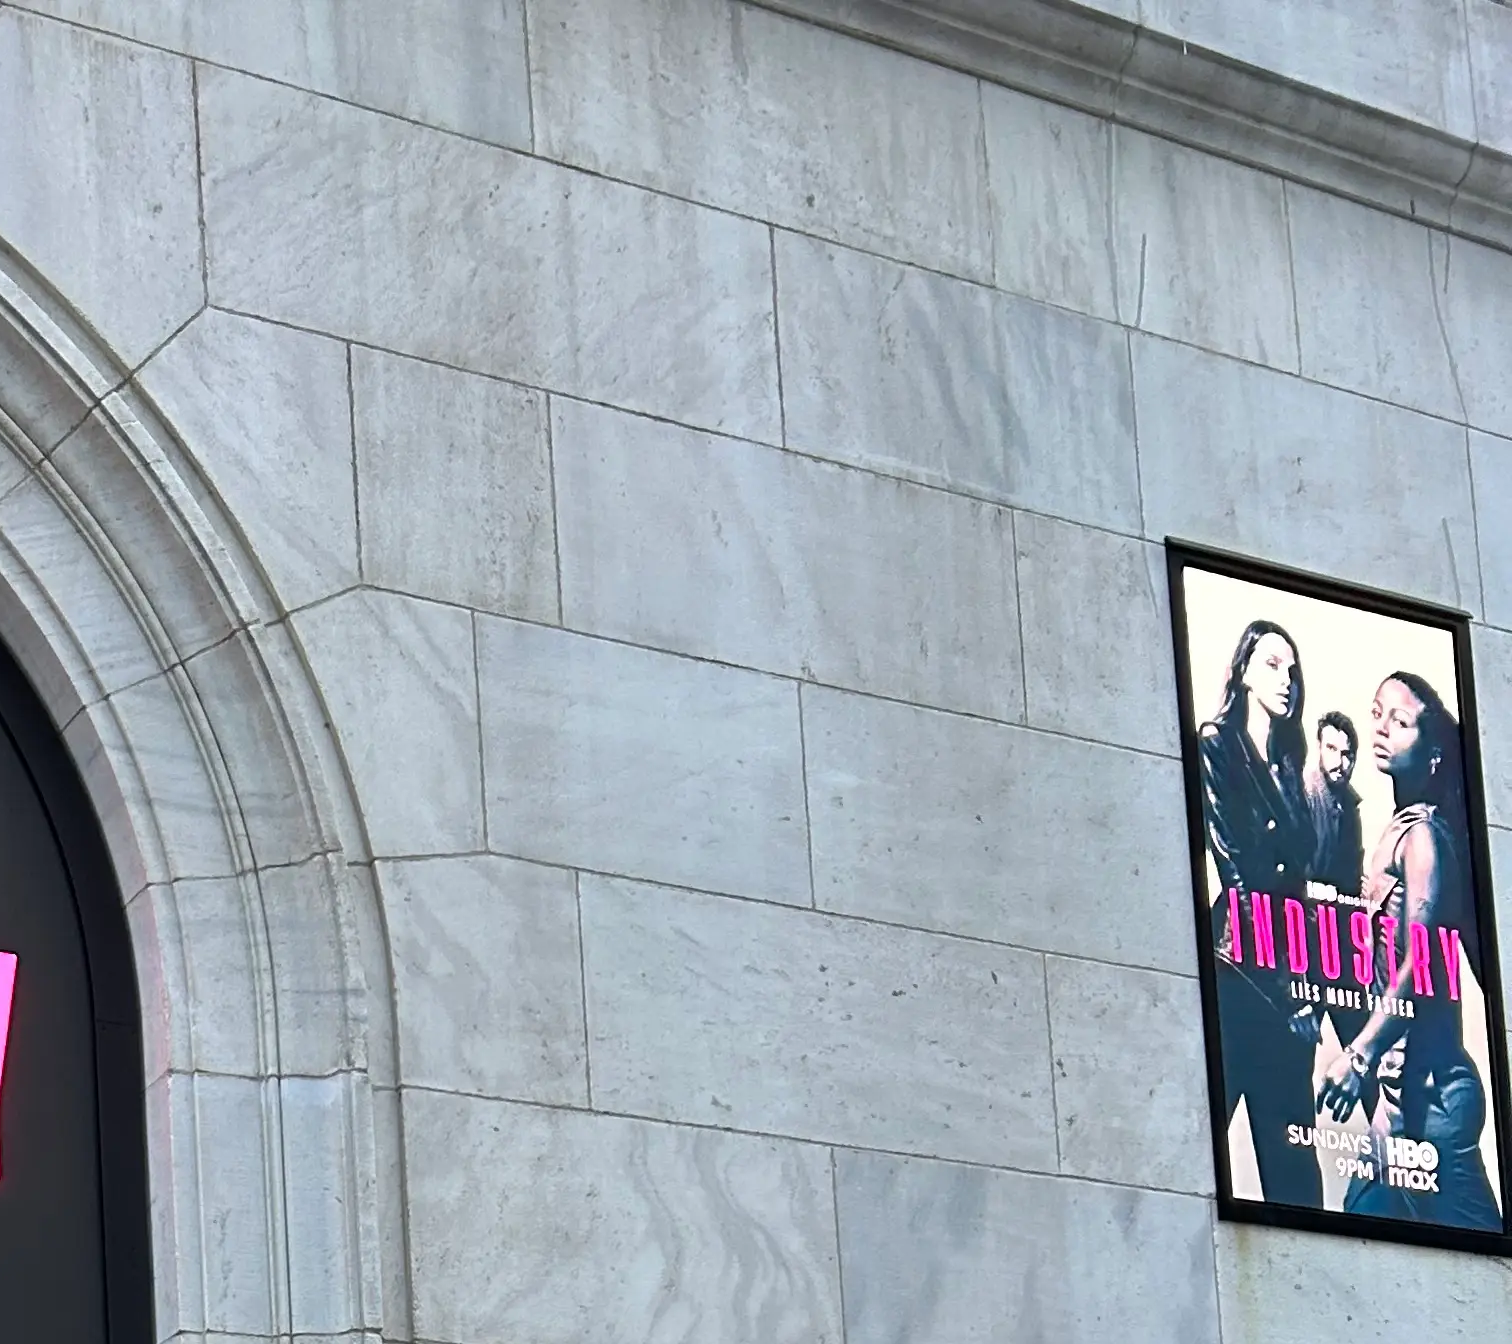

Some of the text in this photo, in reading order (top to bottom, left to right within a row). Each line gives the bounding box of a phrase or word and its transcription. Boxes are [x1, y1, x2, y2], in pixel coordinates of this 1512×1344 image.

[1228, 887, 1459, 1000] INDUSTRY
[1291, 980, 1415, 1018] LIES MOVE FASTER
[1287, 1124, 1373, 1155] SUNDAYS
[1386, 1136, 1439, 1172] HBO
[1335, 1157, 1374, 1181] 9PM
[1388, 1166, 1440, 1193] max
